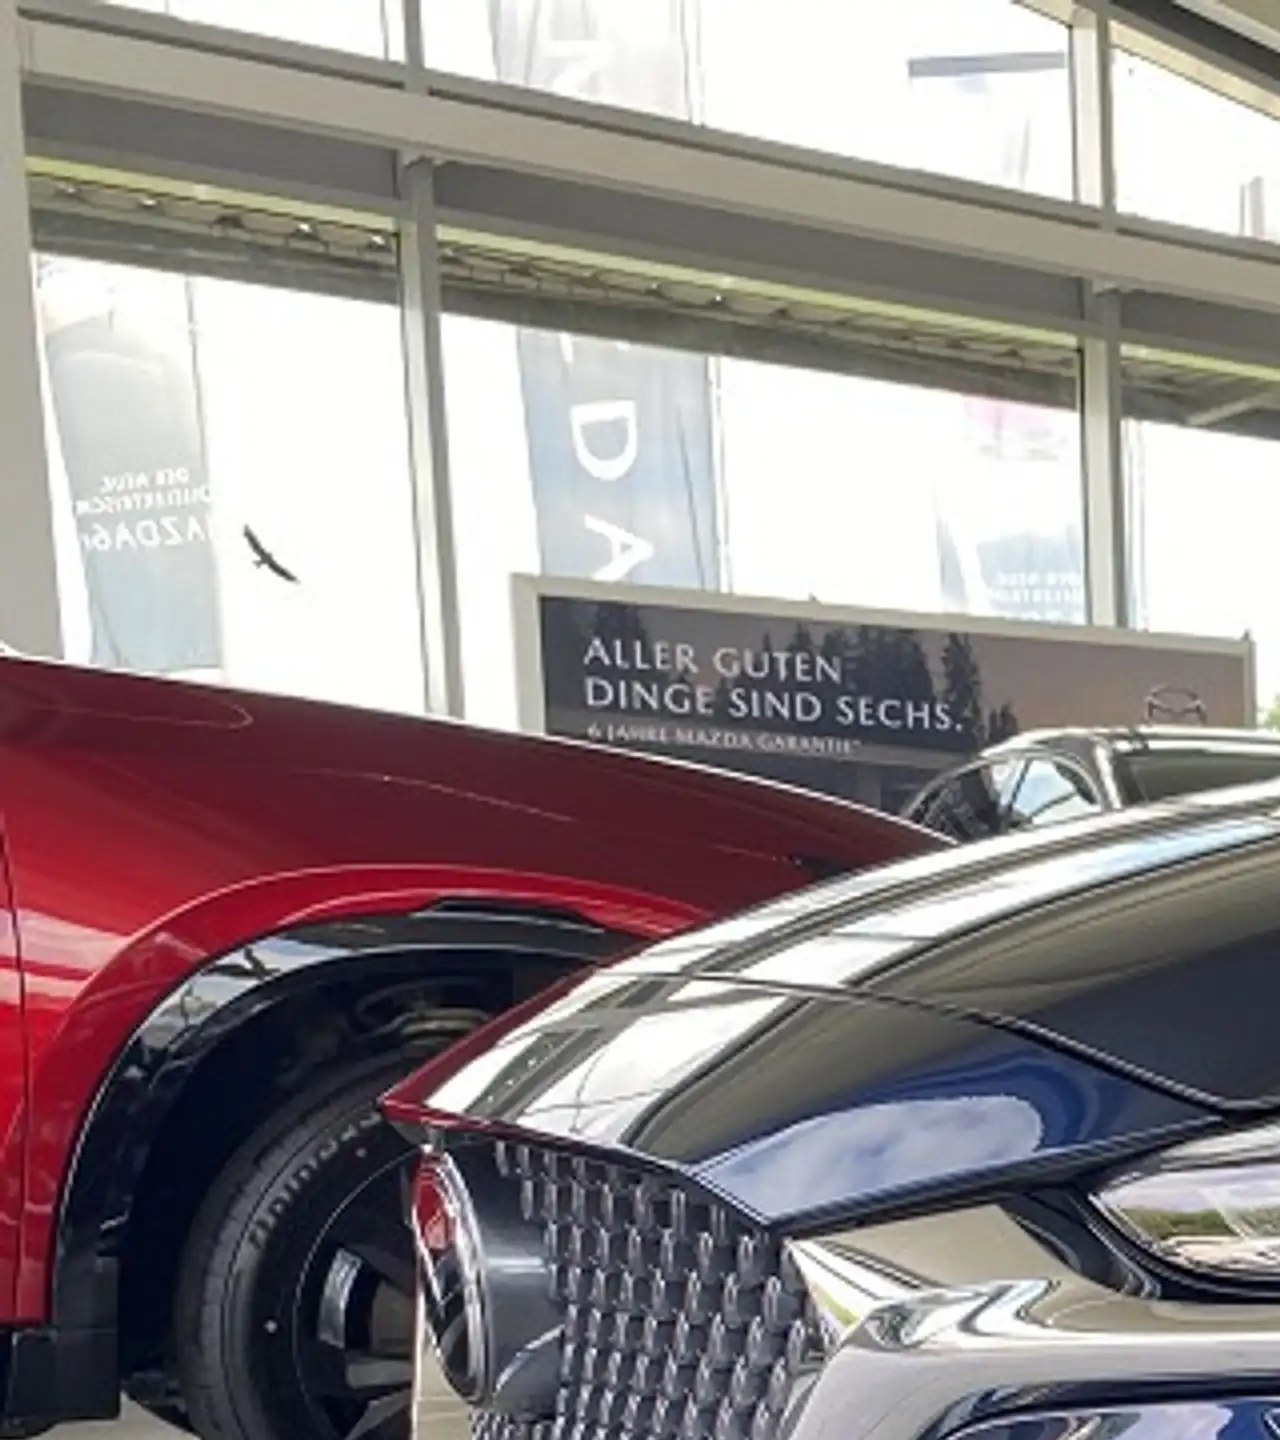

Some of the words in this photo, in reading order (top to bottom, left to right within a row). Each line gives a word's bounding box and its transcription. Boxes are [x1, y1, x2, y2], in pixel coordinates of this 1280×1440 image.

[583, 636, 699, 675] ALLER
[712, 646, 842, 684] GUTEN
[584, 675, 714, 715] DINGE
[727, 685, 822, 722] SIND
[835, 694, 963, 732] SECHS.
[674, 727, 751, 749] MAZDA
